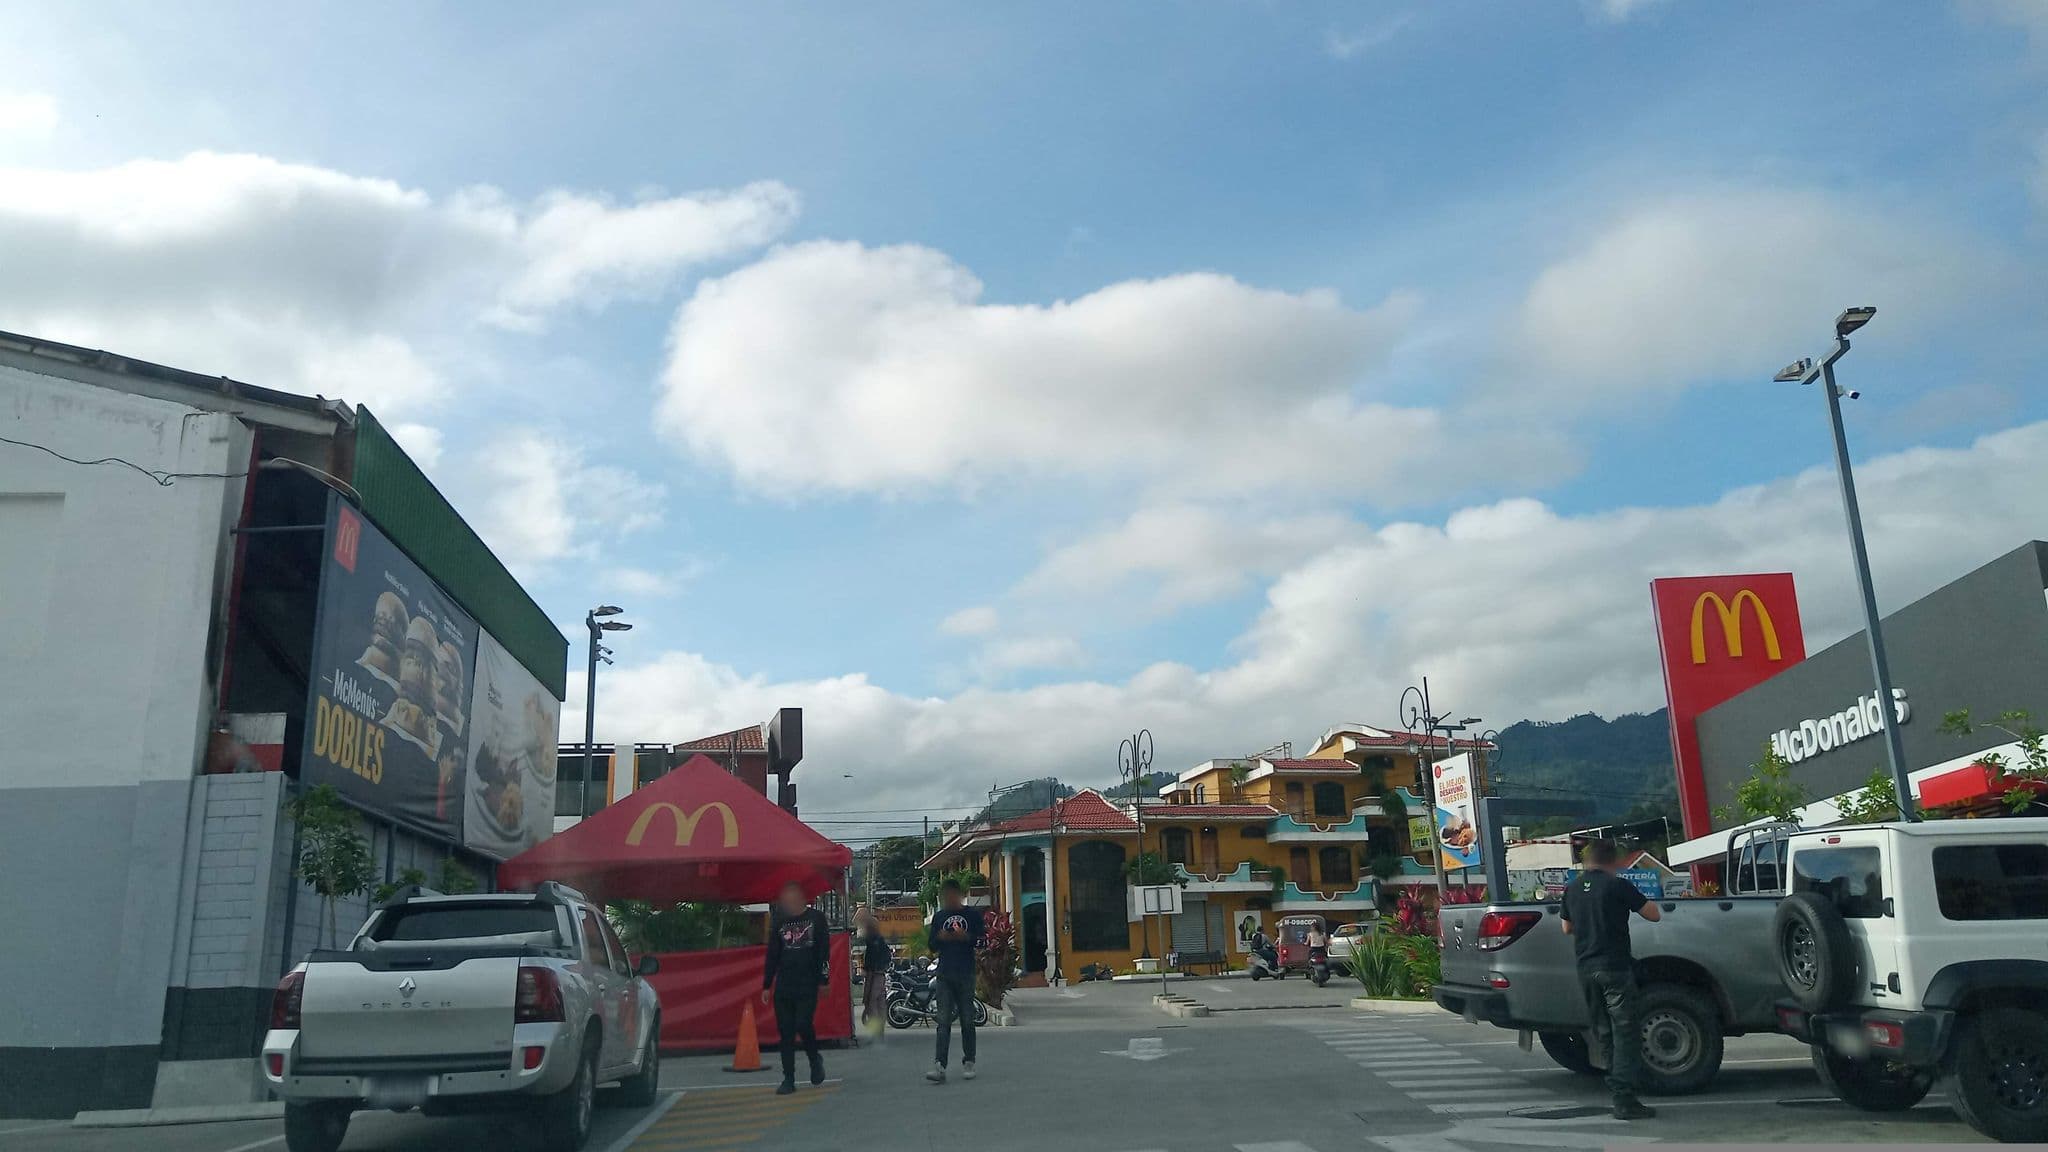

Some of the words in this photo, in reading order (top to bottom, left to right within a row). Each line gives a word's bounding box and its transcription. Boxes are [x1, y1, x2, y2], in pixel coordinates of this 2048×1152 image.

[333, 668, 379, 720] McMenús
[1771, 688, 1911, 764] McDonalds
[313, 695, 385, 785] DOBLES
[1446, 775, 1466, 788] MEJOR
[1439, 784, 1464, 798] DESAYUNO
[1443, 791, 1468, 805] NUESTRO
[361, 1001, 453, 1010] OROCH
